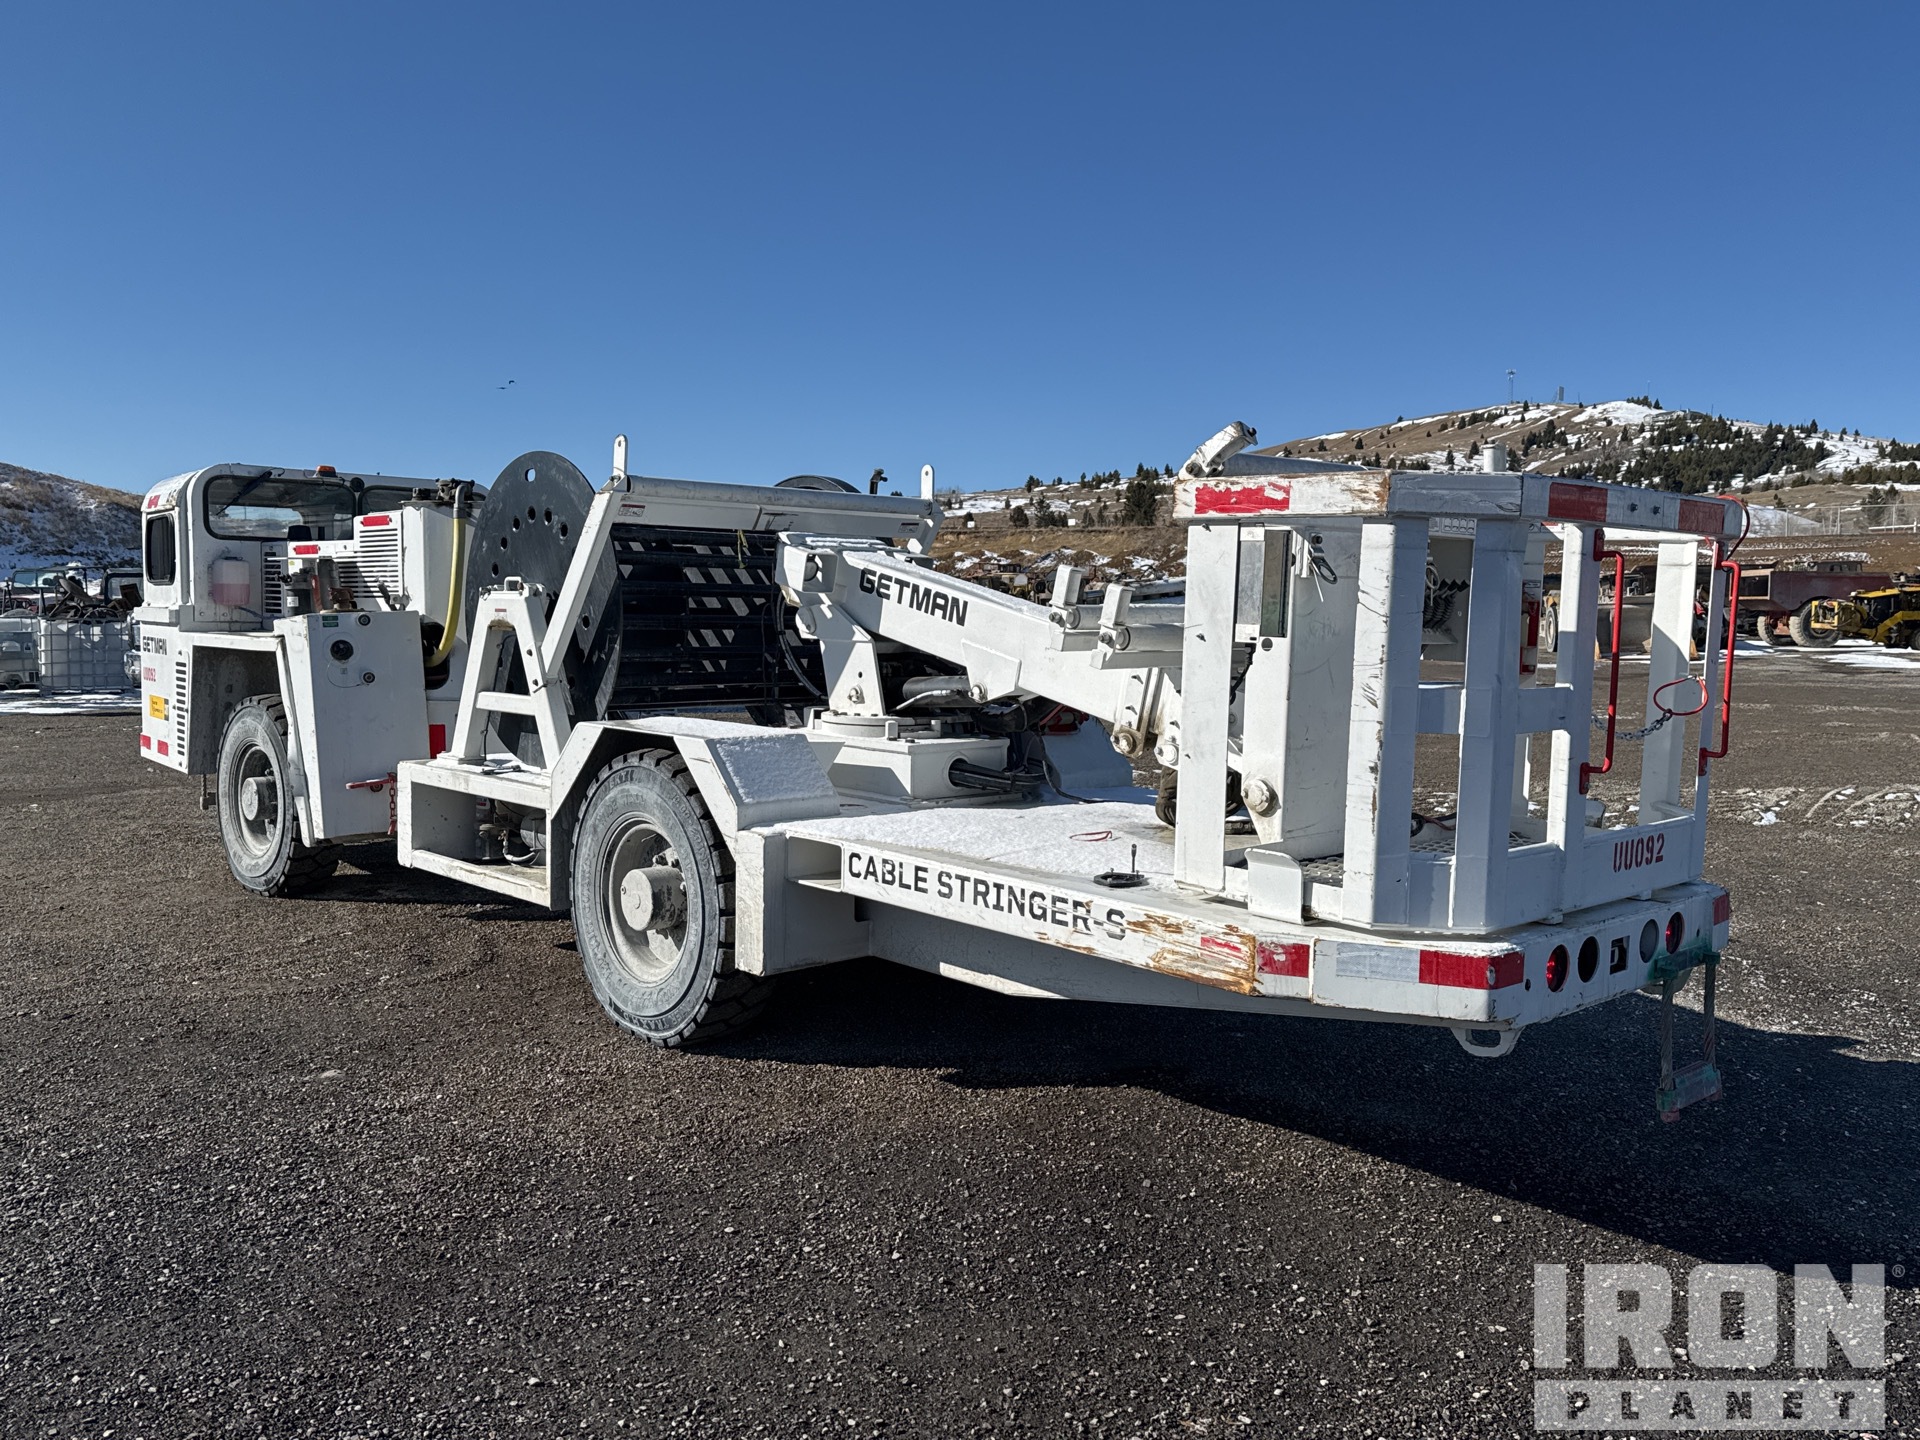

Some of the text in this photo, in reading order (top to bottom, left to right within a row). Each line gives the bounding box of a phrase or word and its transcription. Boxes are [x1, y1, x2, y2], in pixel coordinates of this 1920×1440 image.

[859, 567, 968, 627] GETMAN
[143, 636, 167, 655] GETMAN
[848, 852, 929, 894] CABLE
[1613, 832, 1665, 873] UU092
